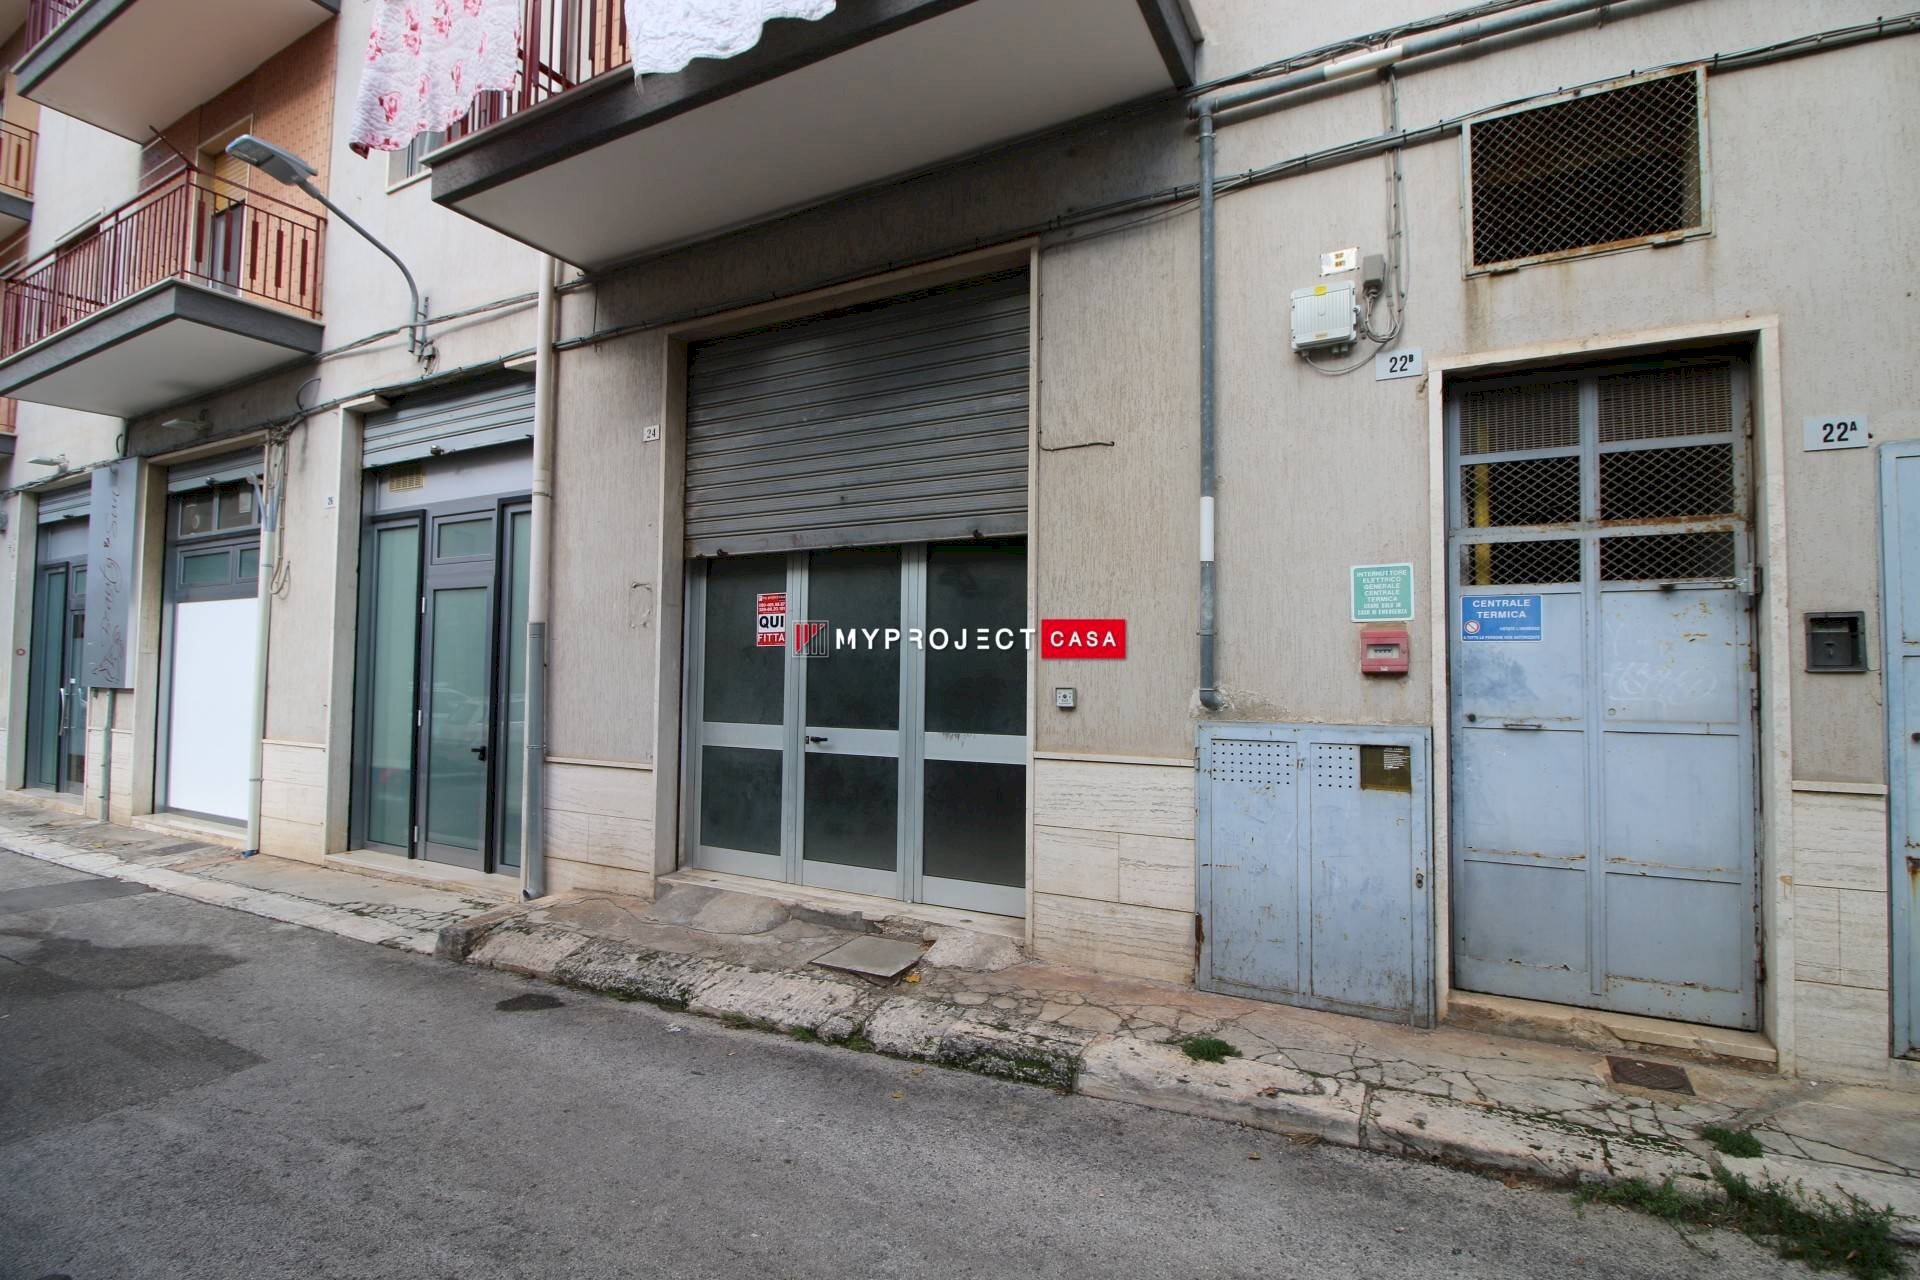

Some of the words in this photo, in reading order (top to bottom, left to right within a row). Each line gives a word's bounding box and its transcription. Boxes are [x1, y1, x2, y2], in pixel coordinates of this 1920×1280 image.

[1389, 354, 1414, 373] 22B
[646, 428, 656, 439] 24
[1823, 421, 1857, 443] 22A
[1472, 598, 1531, 608] CENTRALE
[1476, 610, 1526, 619] TERMICA
[760, 615, 784, 628] QUI
